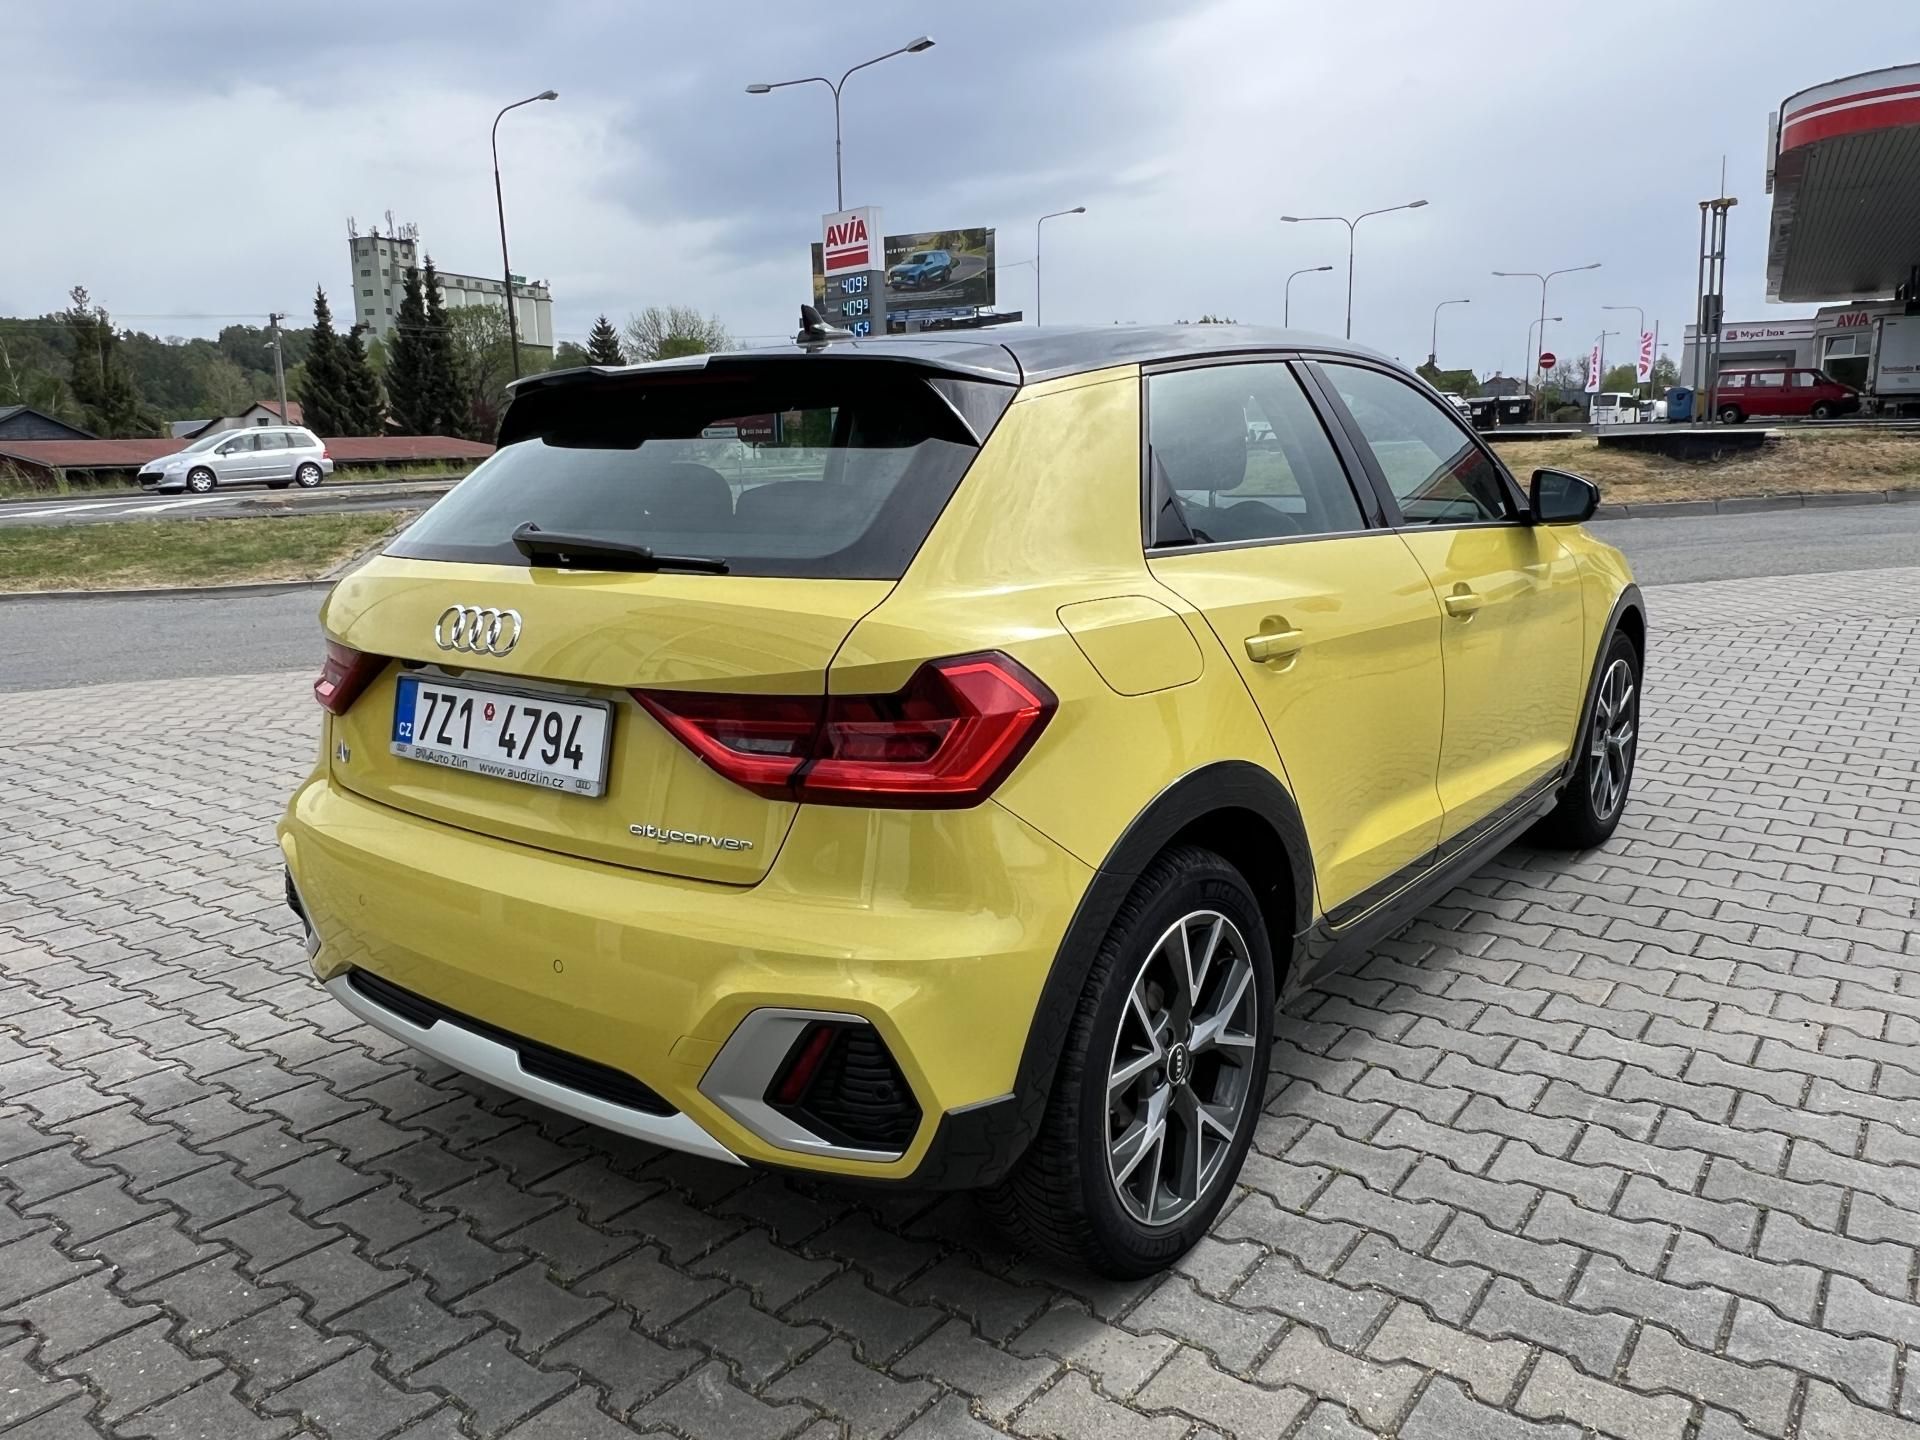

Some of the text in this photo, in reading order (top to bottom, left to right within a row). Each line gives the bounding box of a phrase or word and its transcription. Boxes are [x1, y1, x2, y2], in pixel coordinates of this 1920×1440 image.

[1766, 329, 1785, 337] box
[399, 721, 412, 737] CZ
[419, 691, 583, 770] 7Z1 4794
[629, 823, 754, 851] citycarver
